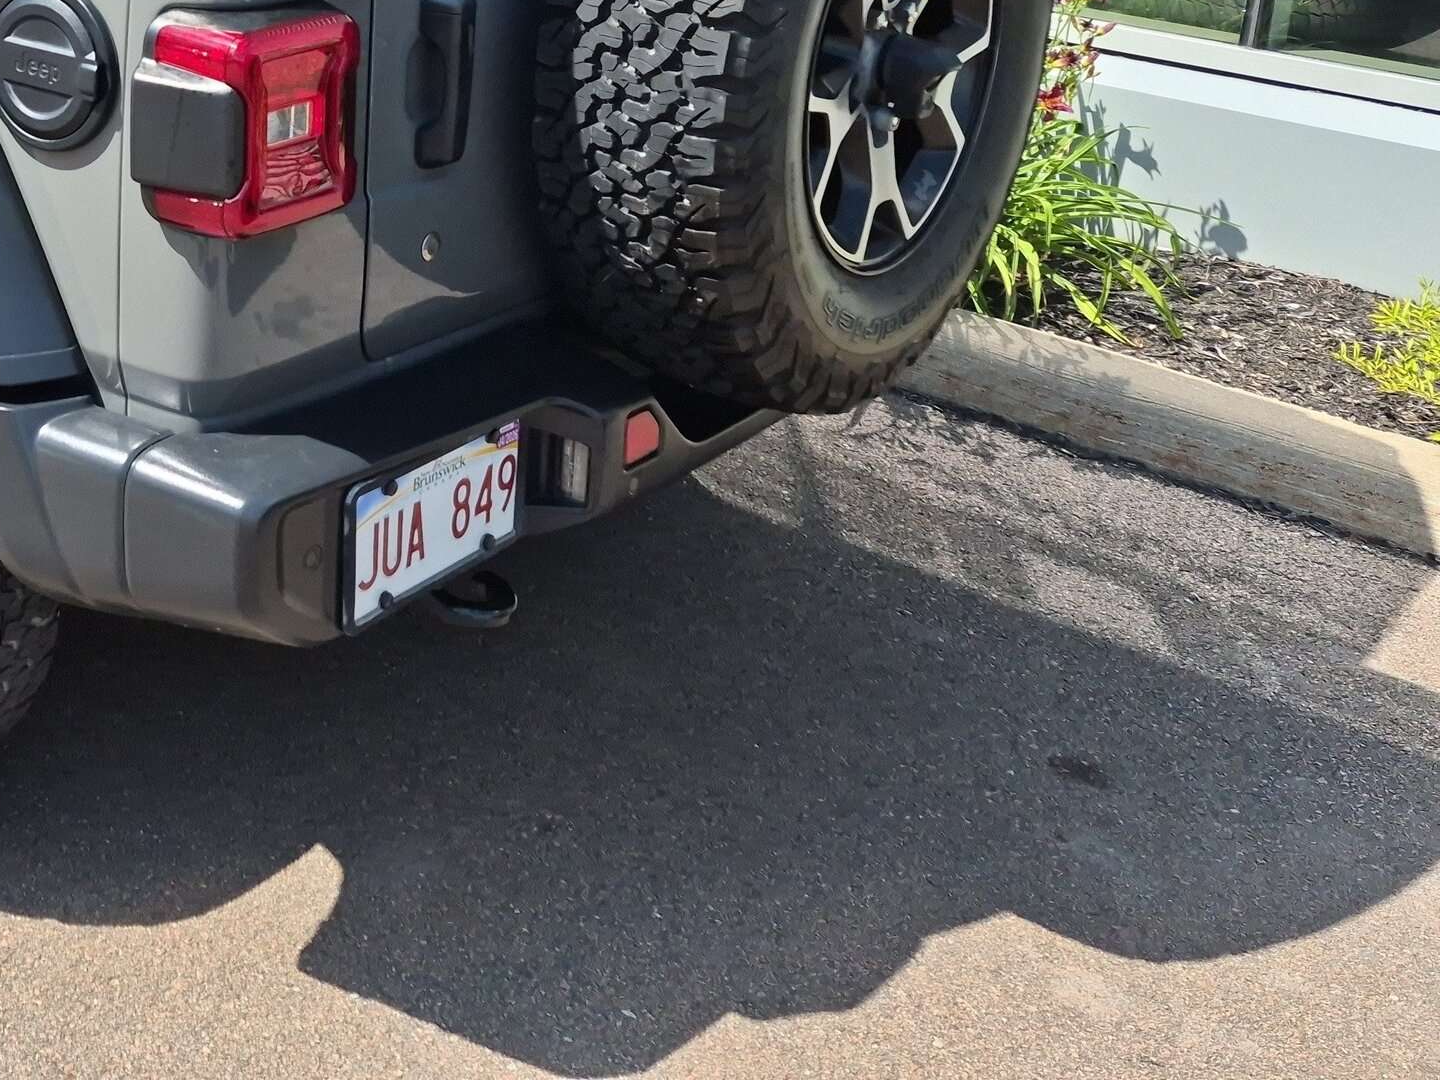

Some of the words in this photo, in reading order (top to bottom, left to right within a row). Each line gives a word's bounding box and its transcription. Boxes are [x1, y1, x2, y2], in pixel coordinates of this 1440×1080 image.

[15, 52, 59, 85] Jeep
[413, 456, 467, 492] Brunswick
[358, 500, 425, 591] JUA
[451, 454, 516, 540] 849
